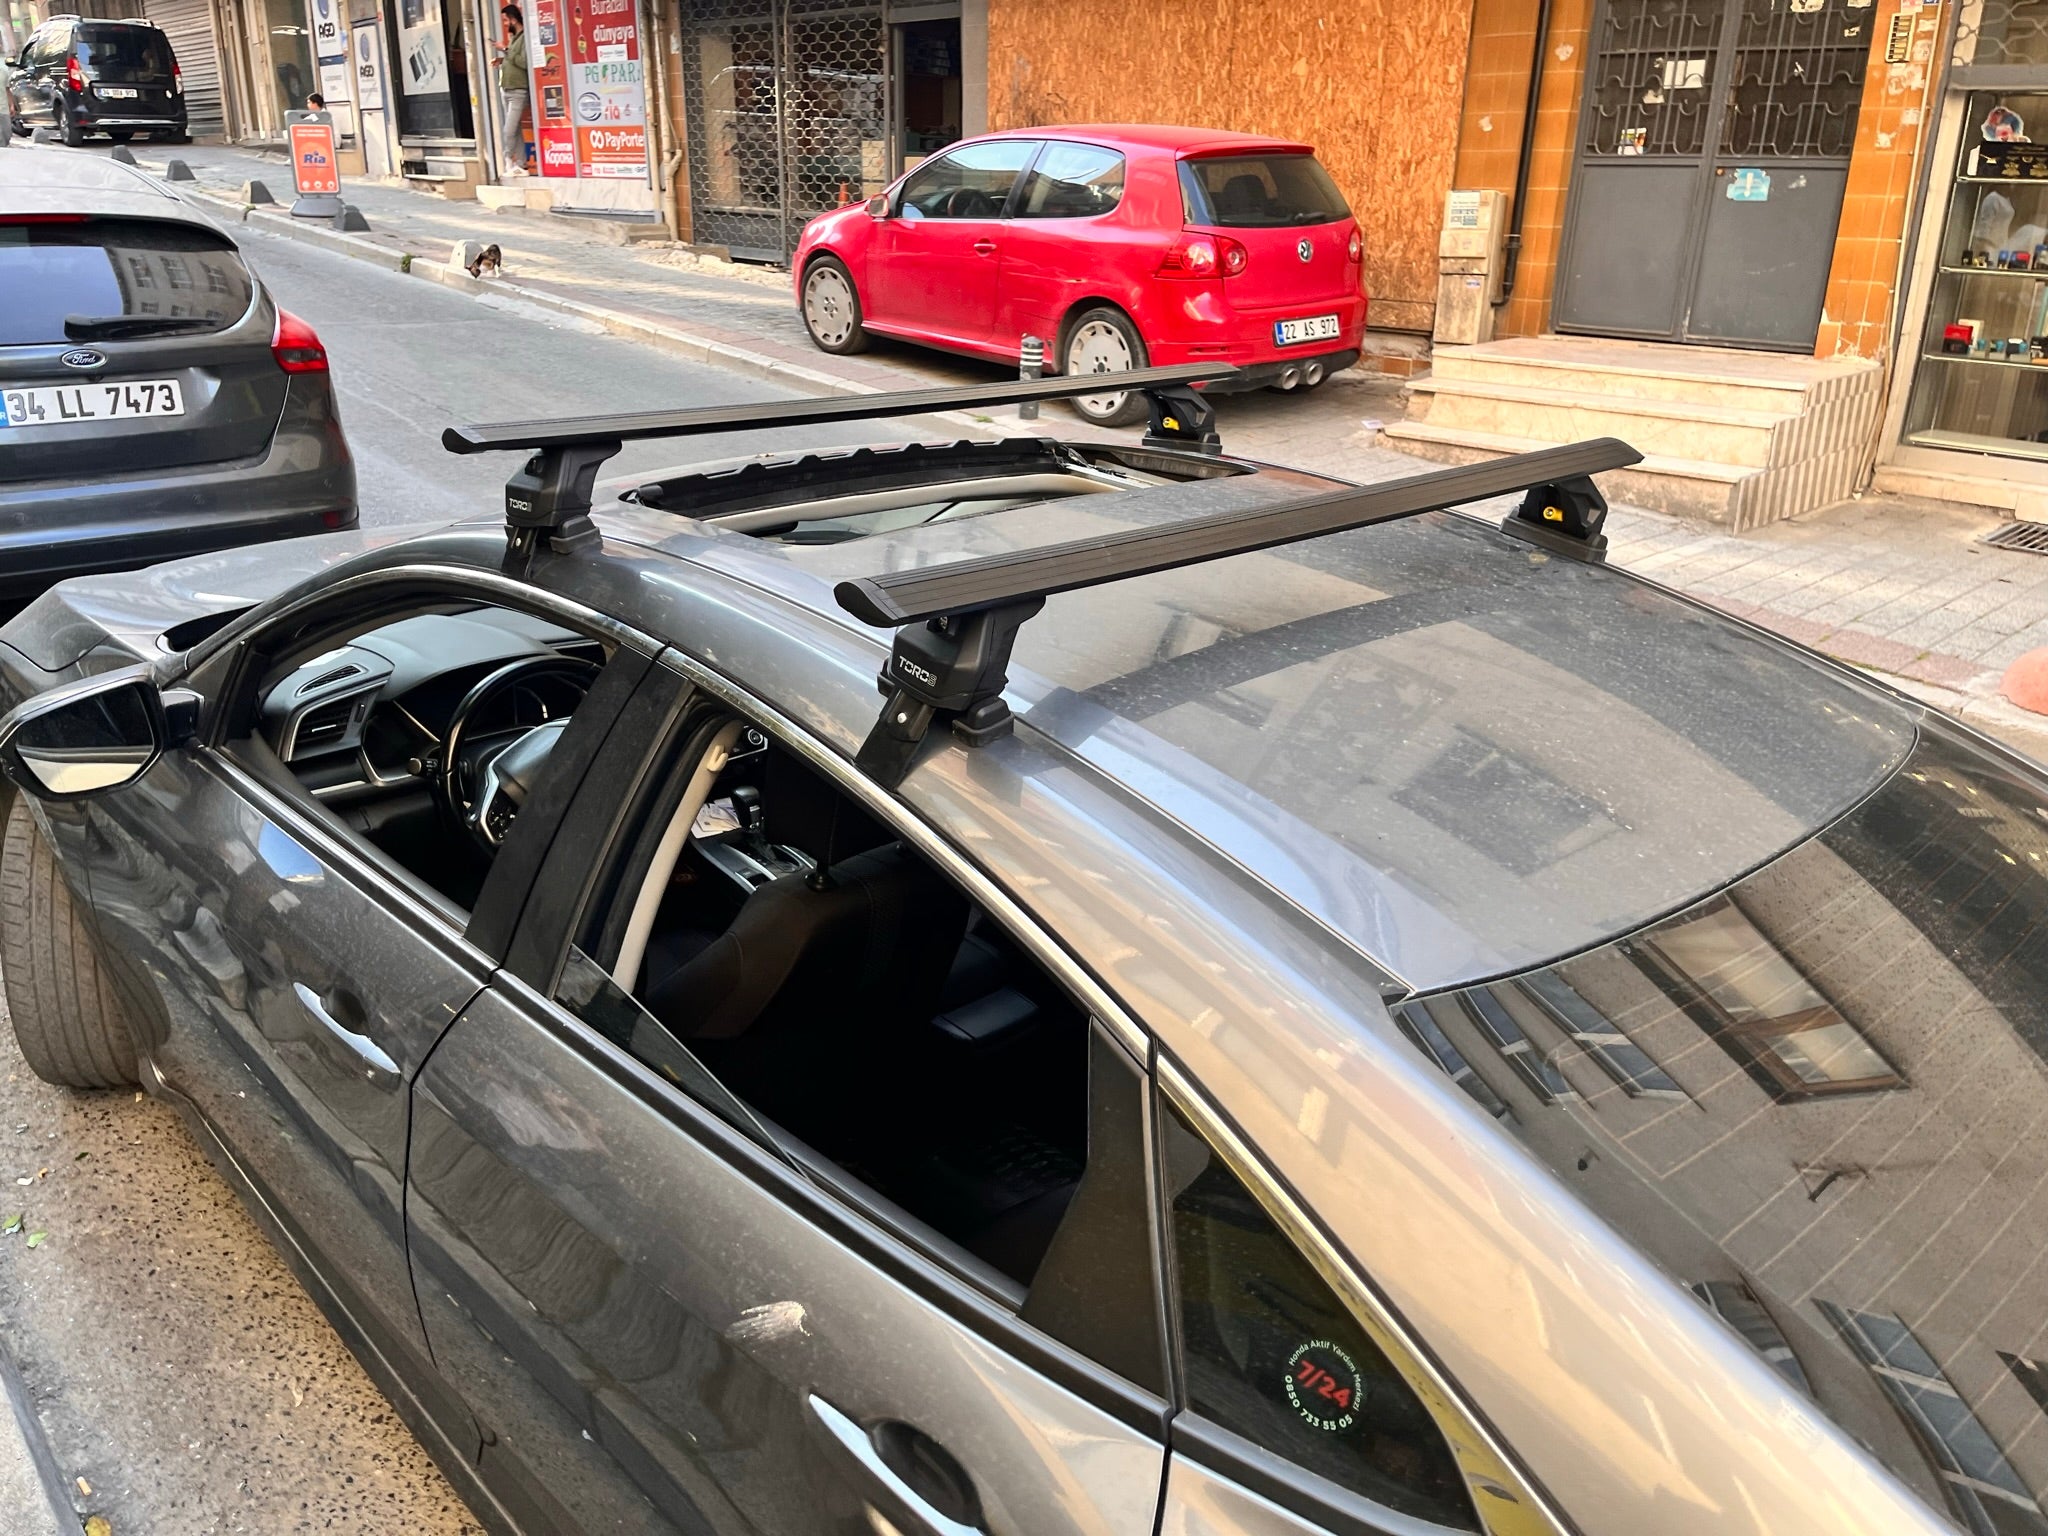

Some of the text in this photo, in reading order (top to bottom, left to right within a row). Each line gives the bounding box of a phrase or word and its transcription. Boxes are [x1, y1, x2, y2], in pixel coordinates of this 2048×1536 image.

[593, 24, 635, 44] dünyaya
[605, 130, 645, 151] PayPorte
[303, 150, 327, 164] Ria
[544, 151, 575, 167] Корона
[1284, 318, 1337, 340] 22 AS 972
[72, 353, 97, 364] Ford
[7, 384, 175, 422] 34 LL 7473
[899, 655, 938, 687] TOROS
[1288, 1343, 1309, 1366] Honda
[1310, 1340, 1331, 1349] Aktif
[1353, 1373, 1365, 1411] Merkezi
[1297, 1359, 1351, 1408] 7/24
[1284, 1374, 1353, 1430] 0850 733 55 05
